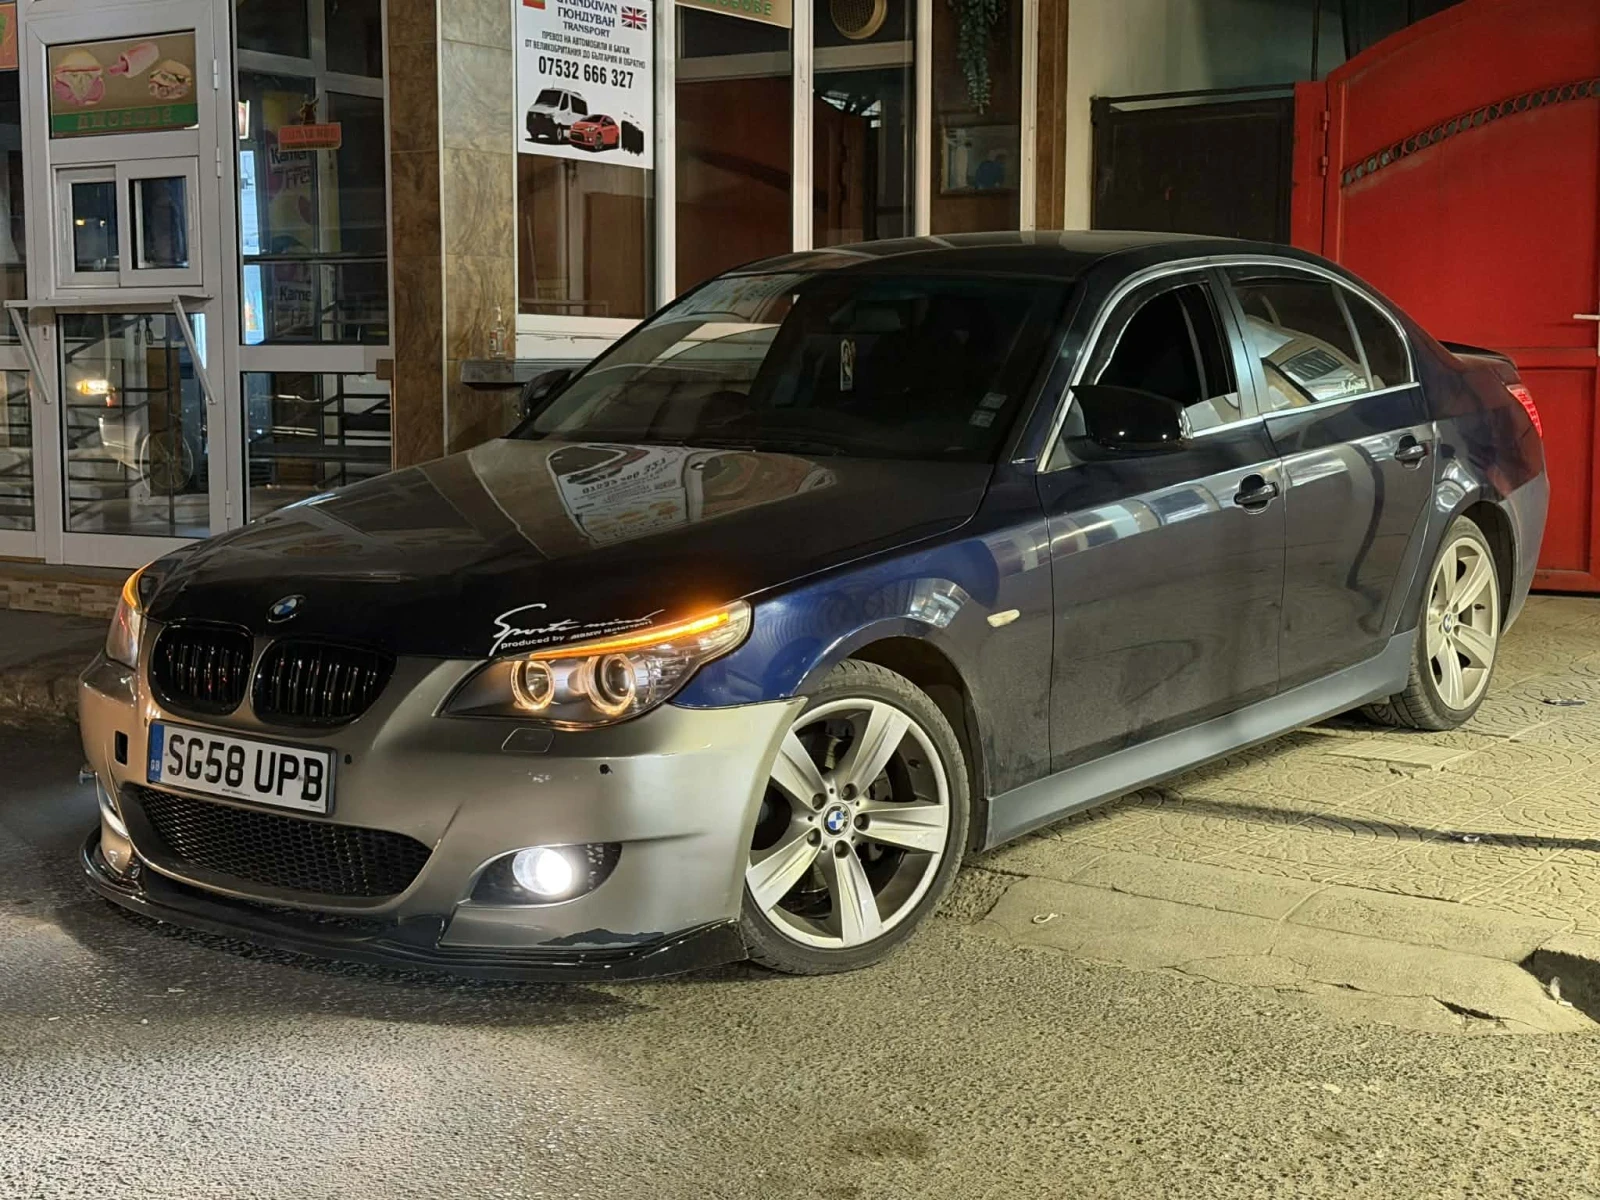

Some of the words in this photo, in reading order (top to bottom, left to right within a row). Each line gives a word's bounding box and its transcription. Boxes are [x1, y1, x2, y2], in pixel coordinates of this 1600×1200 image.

[558, 6, 615, 28] ГЮНДУВАН
[563, 20, 610, 38] TRANSPORT
[542, 31, 563, 42] ПРЕВОЗ
[564, 34, 571, 44] НА
[614, 44, 630, 55] БАГАЖ
[538, 55, 579, 80] 07532
[583, 63, 607, 86] 666
[611, 68, 634, 89] 327
[501, 636, 550, 650] produced
[552, 635, 565, 643] by
[603, 619, 653, 635] Motorsport
[150, 760, 160, 771] GB
[168, 734, 245, 787] SG58
[254, 749, 323, 801] UPB
